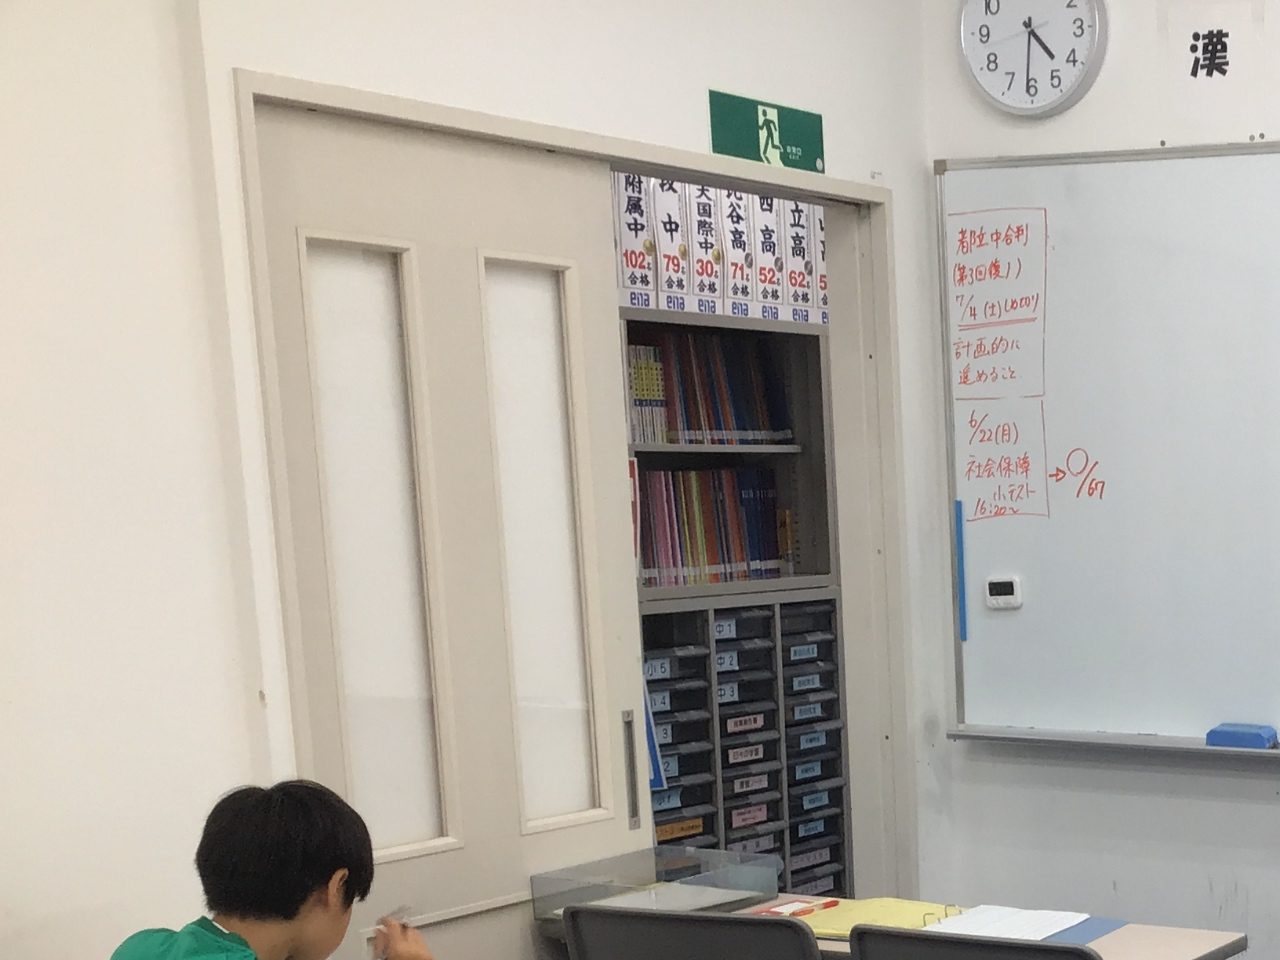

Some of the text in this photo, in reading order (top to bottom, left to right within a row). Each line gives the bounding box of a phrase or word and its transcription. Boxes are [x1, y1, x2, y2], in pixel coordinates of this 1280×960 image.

[978, 24, 990, 44] 9
[1072, 17, 1085, 38] 3
[986, 52, 998, 72] 8
[1065, 48, 1078, 68] 4
[1004, 71, 1016, 91] 7
[1050, 69, 1062, 89] 5
[630, 291, 650, 308] ena
[666, 295, 685, 311] ena
[698, 298, 717, 314] ena
[731, 301, 749, 317] ena
[762, 305, 779, 320] ena
[792, 307, 809, 322] ena
[965, 451, 1031, 481] 社会保障
